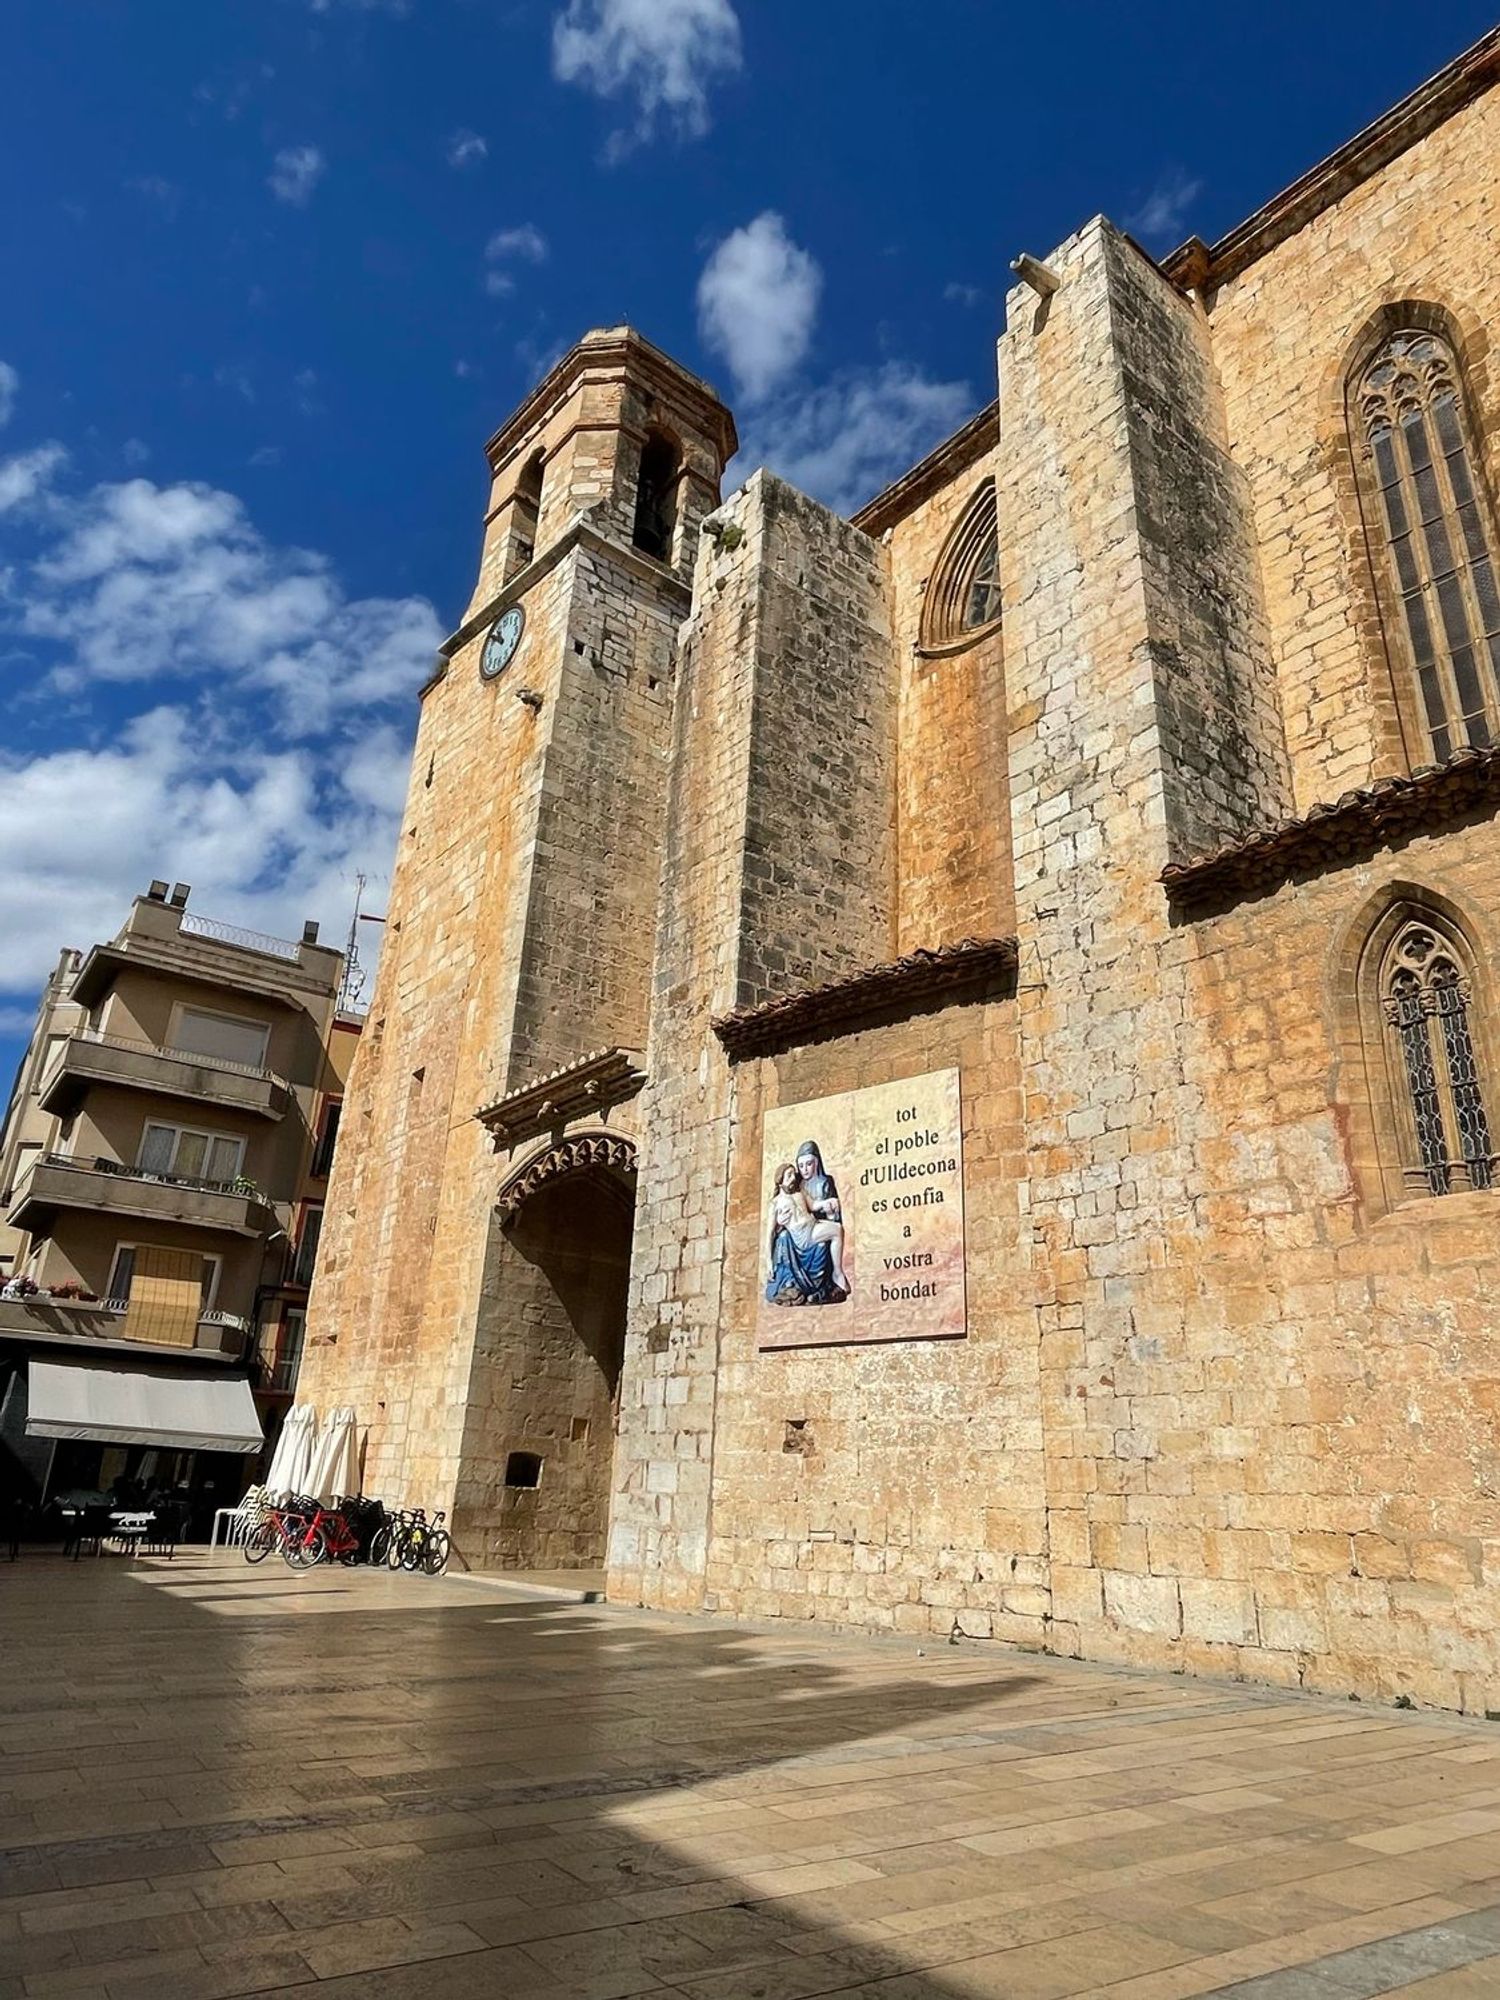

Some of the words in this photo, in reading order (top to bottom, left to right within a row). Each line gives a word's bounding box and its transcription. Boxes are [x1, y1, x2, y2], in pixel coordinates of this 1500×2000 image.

[896, 1106, 917, 1123] tot
[875, 1137, 889, 1155] el
[894, 1129, 939, 1156] poble
[860, 1158, 956, 1186] d'Ulldecona
[871, 1199, 888, 1213] es
[903, 1225, 912, 1238] a
[883, 1252, 933, 1270] vostra
[880, 1281, 938, 1302] bondat
